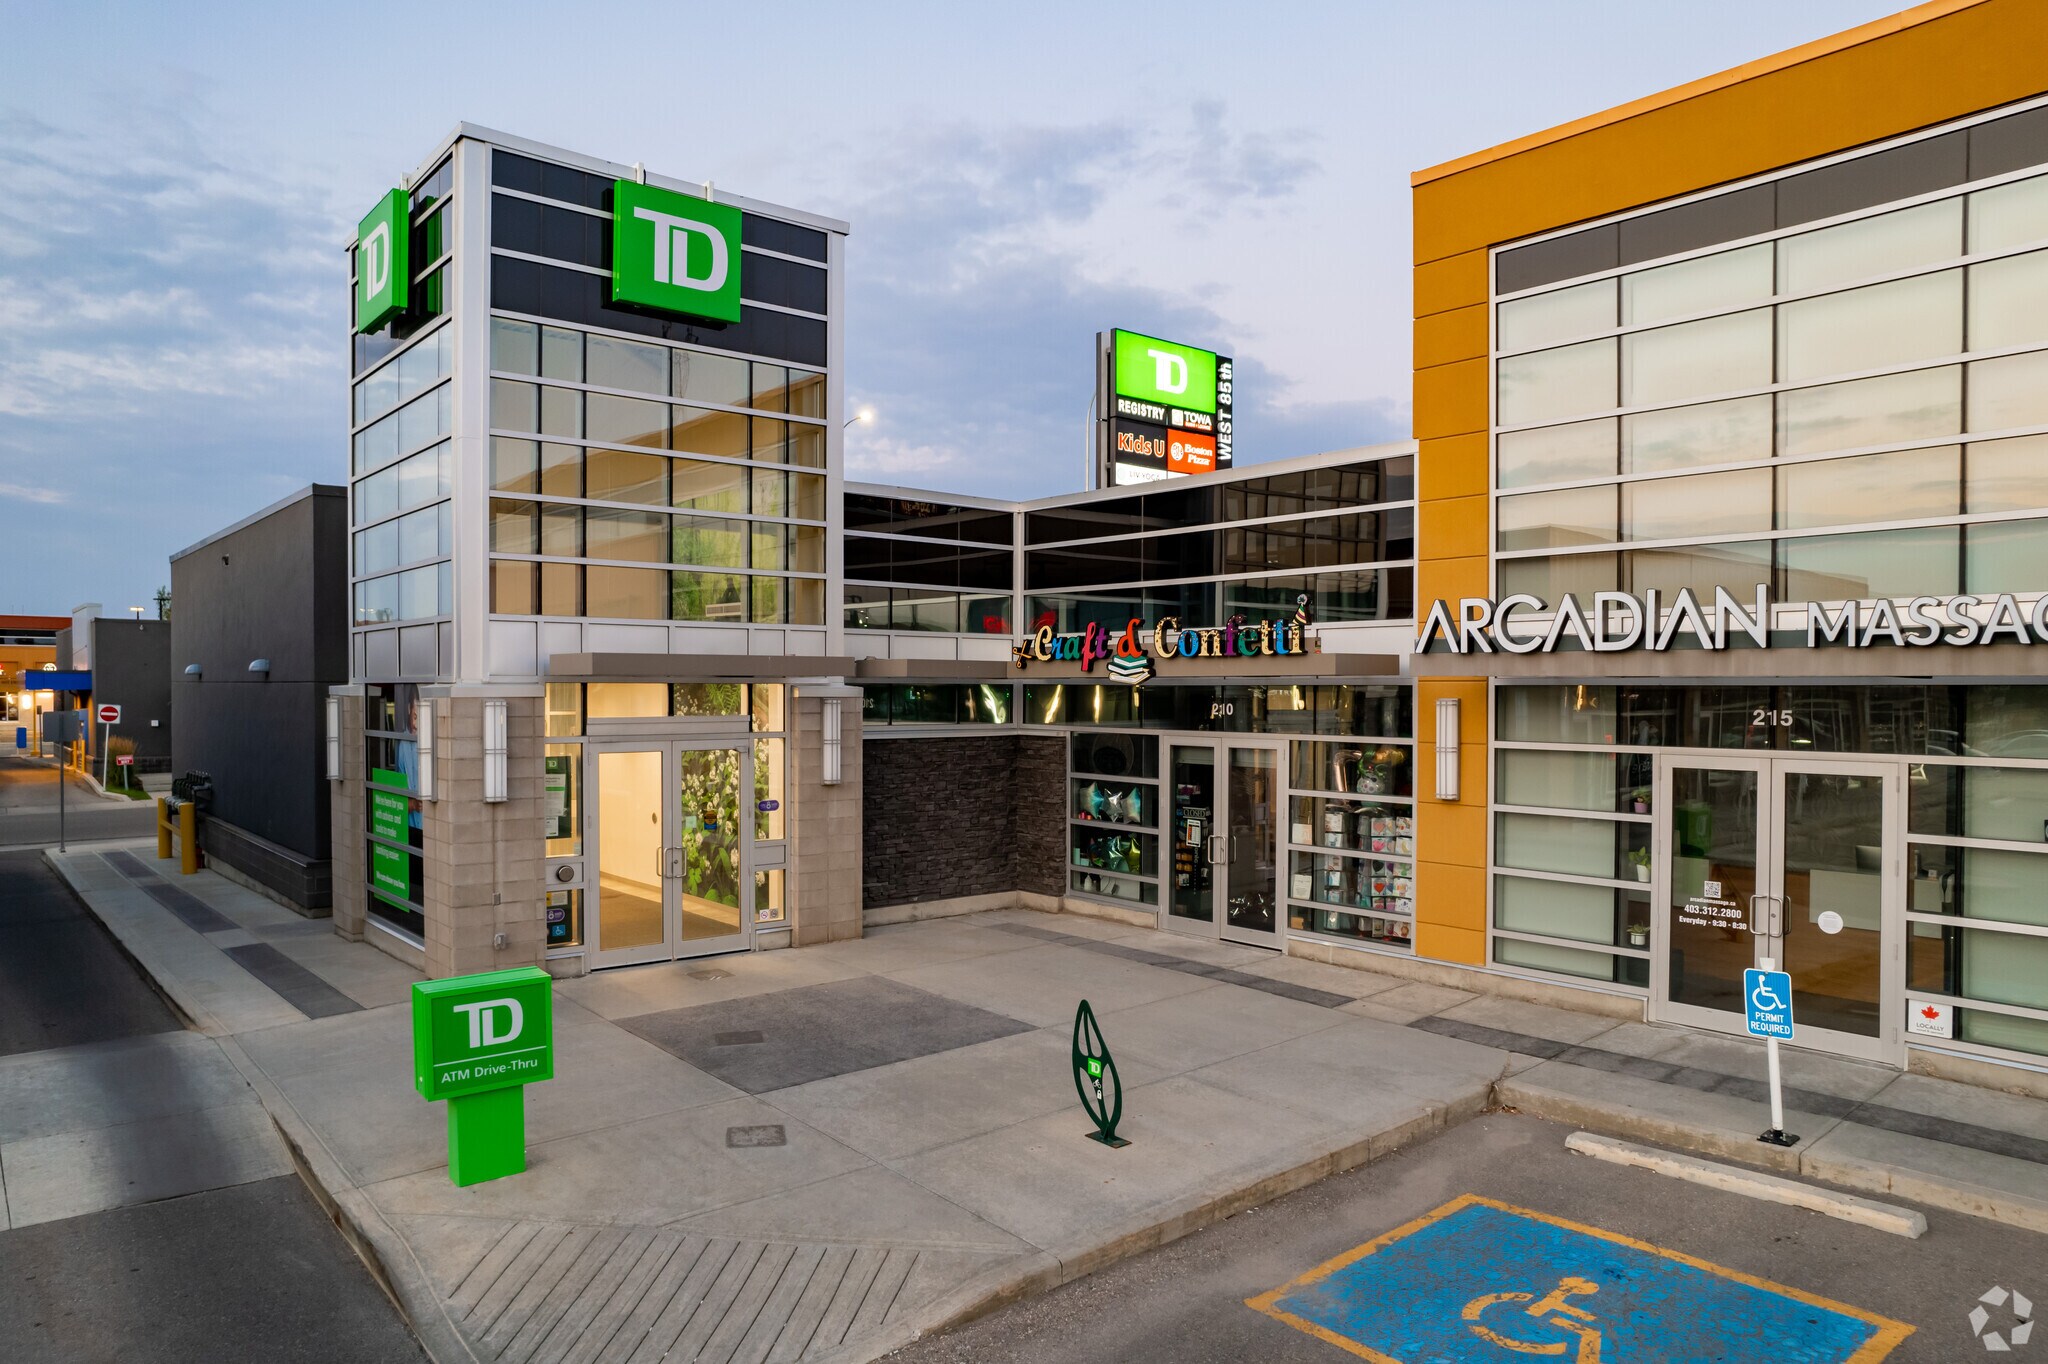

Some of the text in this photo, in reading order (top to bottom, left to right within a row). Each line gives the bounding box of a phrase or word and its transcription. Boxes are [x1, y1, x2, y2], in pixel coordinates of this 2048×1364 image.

[632, 206, 729, 293] TD
[361, 220, 390, 302] TD
[1147, 348, 1188, 395] TD
[1117, 398, 1166, 421] REGISTRY
[1183, 410, 1212, 426] TOWA
[1217, 362, 1232, 461] WEST 85th
[1117, 432, 1152, 455] Kids
[1153, 438, 1165, 458] U
[1184, 443, 1213, 457] Boston
[1187, 454, 1211, 466] Pizza
[1415, 583, 1767, 655] ARCADIAN
[1034, 621, 1110, 672] Craft
[1153, 614, 1303, 659] Confetti
[1212, 702, 1234, 716] 210
[1752, 708, 1794, 727] 215
[1183, 807, 1206, 818] CLOSED
[1684, 904, 1742, 919] 403.312.2800
[1678, 915, 1707, 927] Everyday
[453, 997, 524, 1049] TD
[1755, 1011, 1785, 1023] PERMIT
[1750, 1021, 1791, 1035] REQUIRED
[1916, 1022, 1945, 1032] LOCALLY
[441, 1058, 538, 1084] ATM Drive-Thru
[1088, 1060, 1101, 1075] TD
